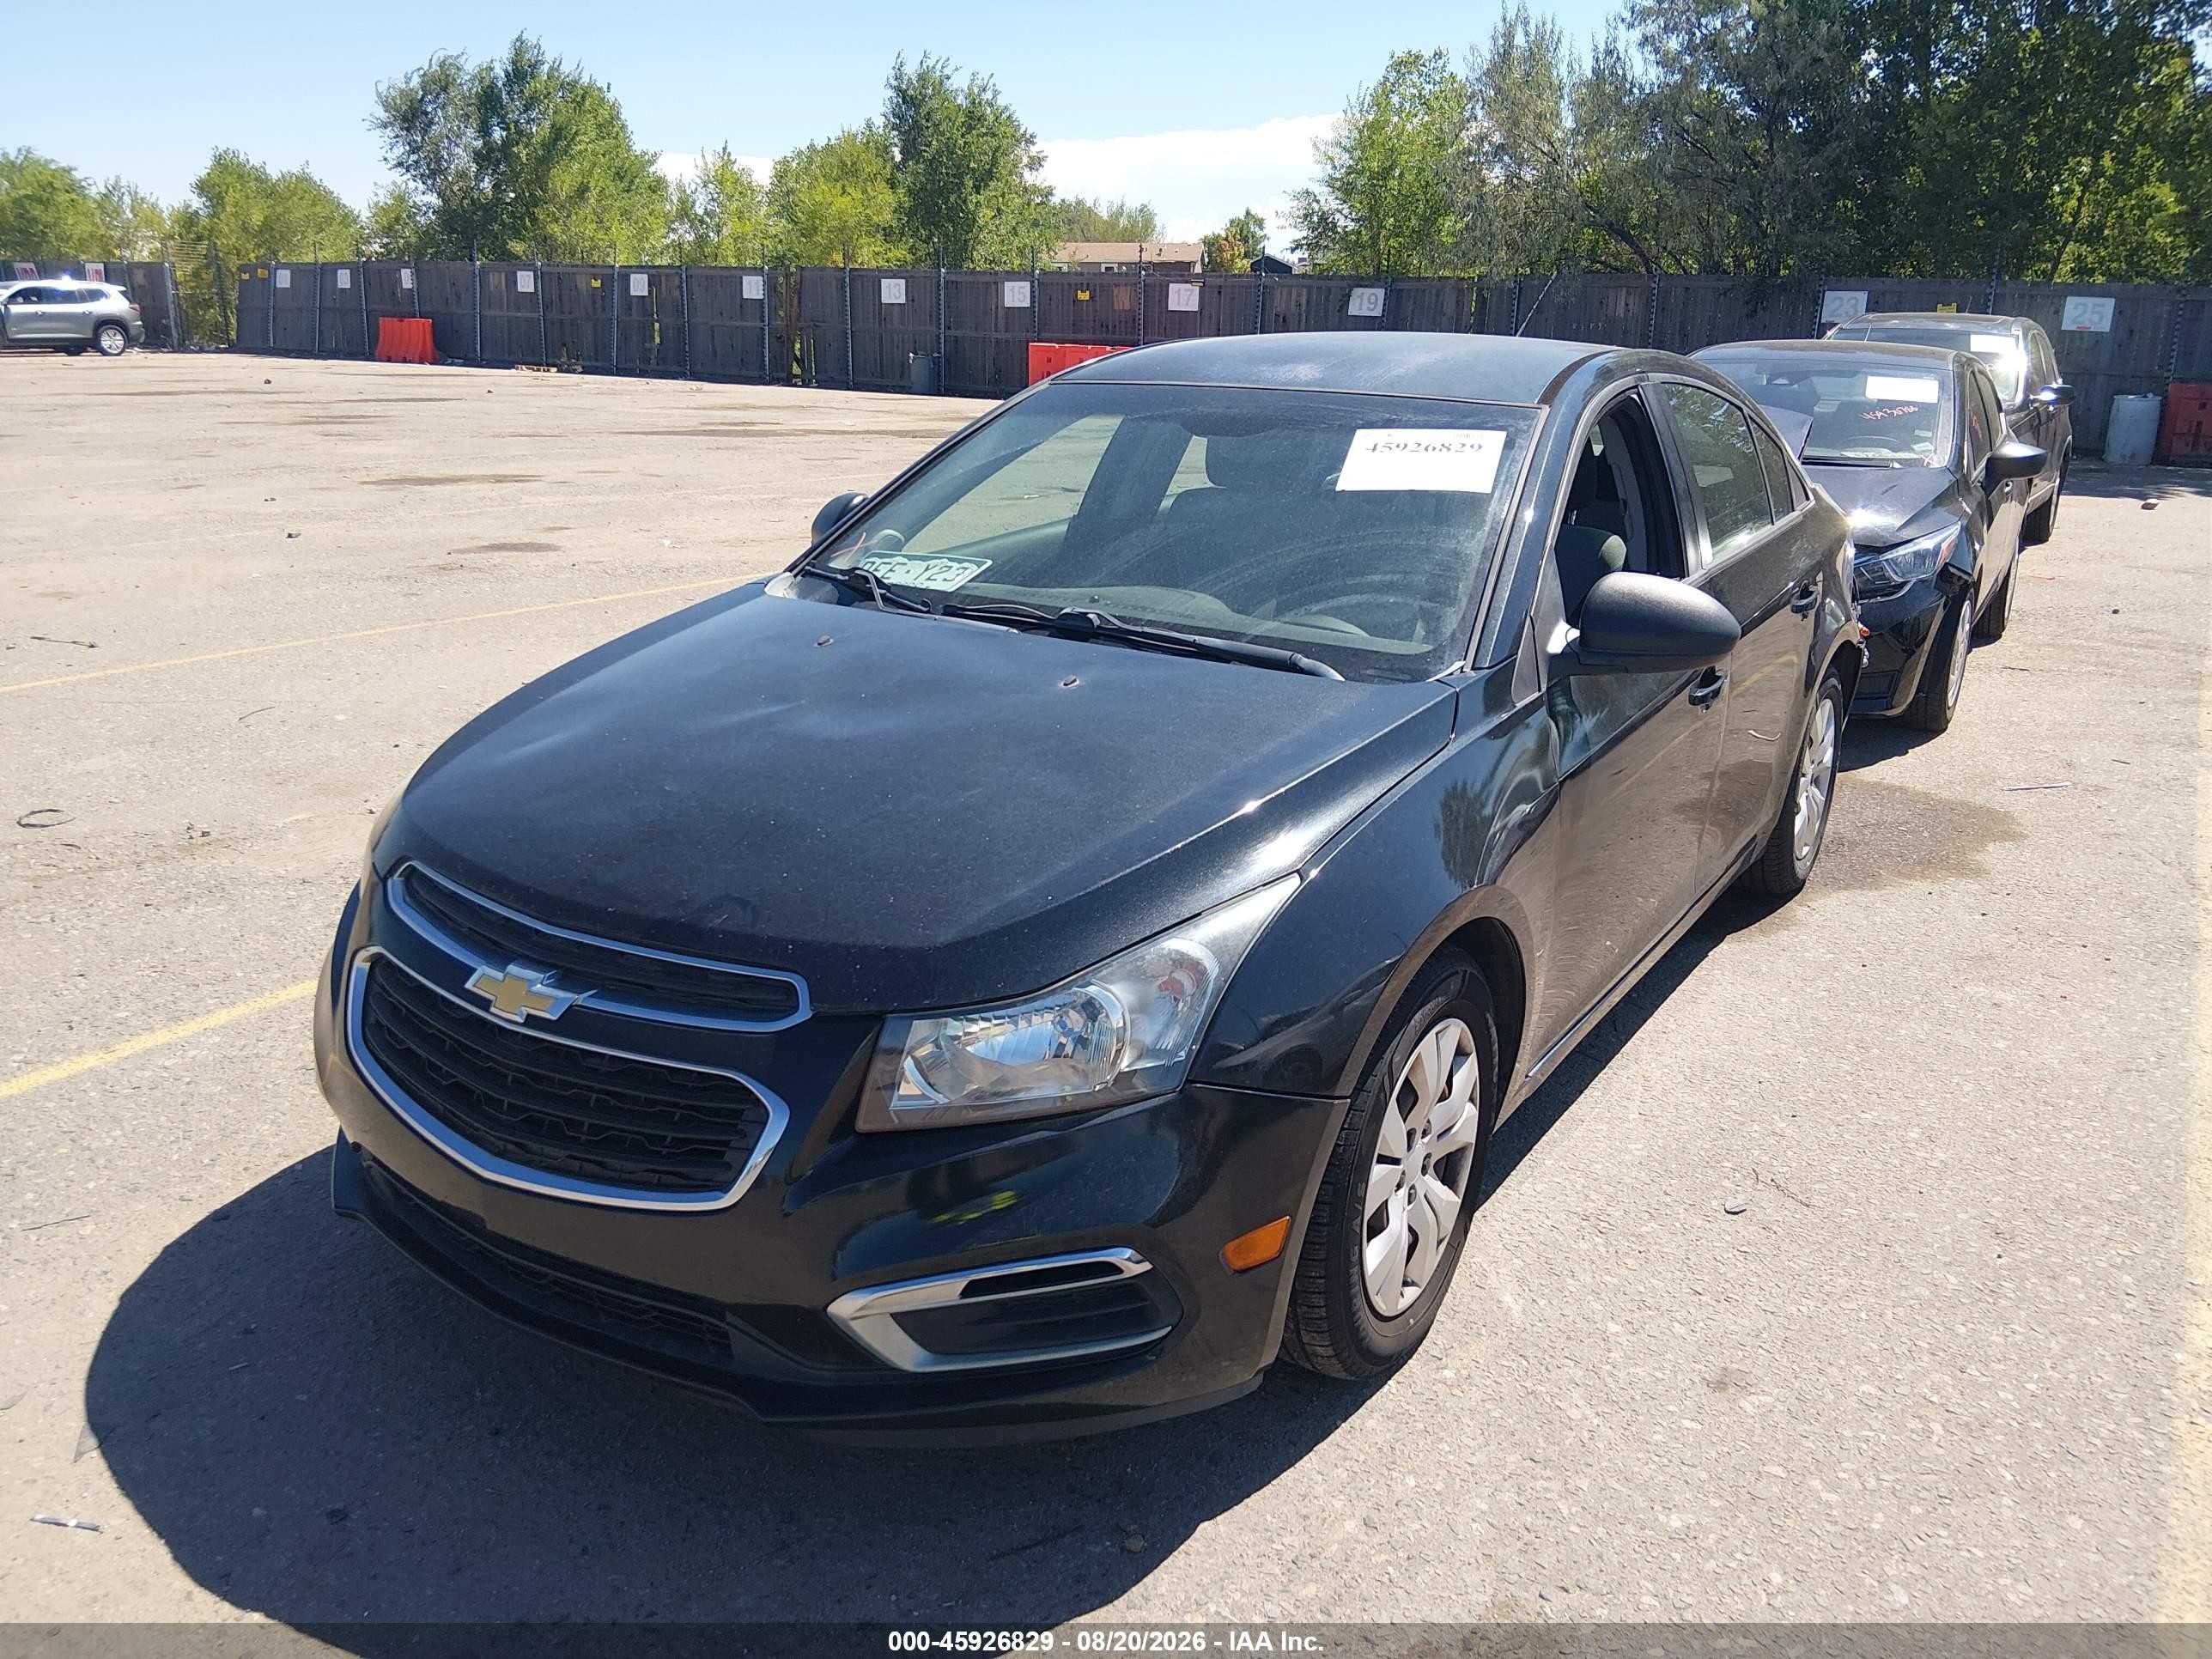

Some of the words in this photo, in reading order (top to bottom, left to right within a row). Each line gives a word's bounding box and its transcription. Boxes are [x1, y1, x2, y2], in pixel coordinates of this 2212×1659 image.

[520, 274, 531, 289] 07
[633, 277, 646, 292] 09
[747, 280, 761, 295] 11
[885, 283, 902, 300] 13
[1009, 286, 1026, 303] 15
[1174, 288, 1194, 307] 17
[1356, 292, 1379, 312] 19
[1829, 296, 1859, 317] 23
[2070, 302, 2106, 325] 25
[1365, 441, 1483, 453] 45926829
